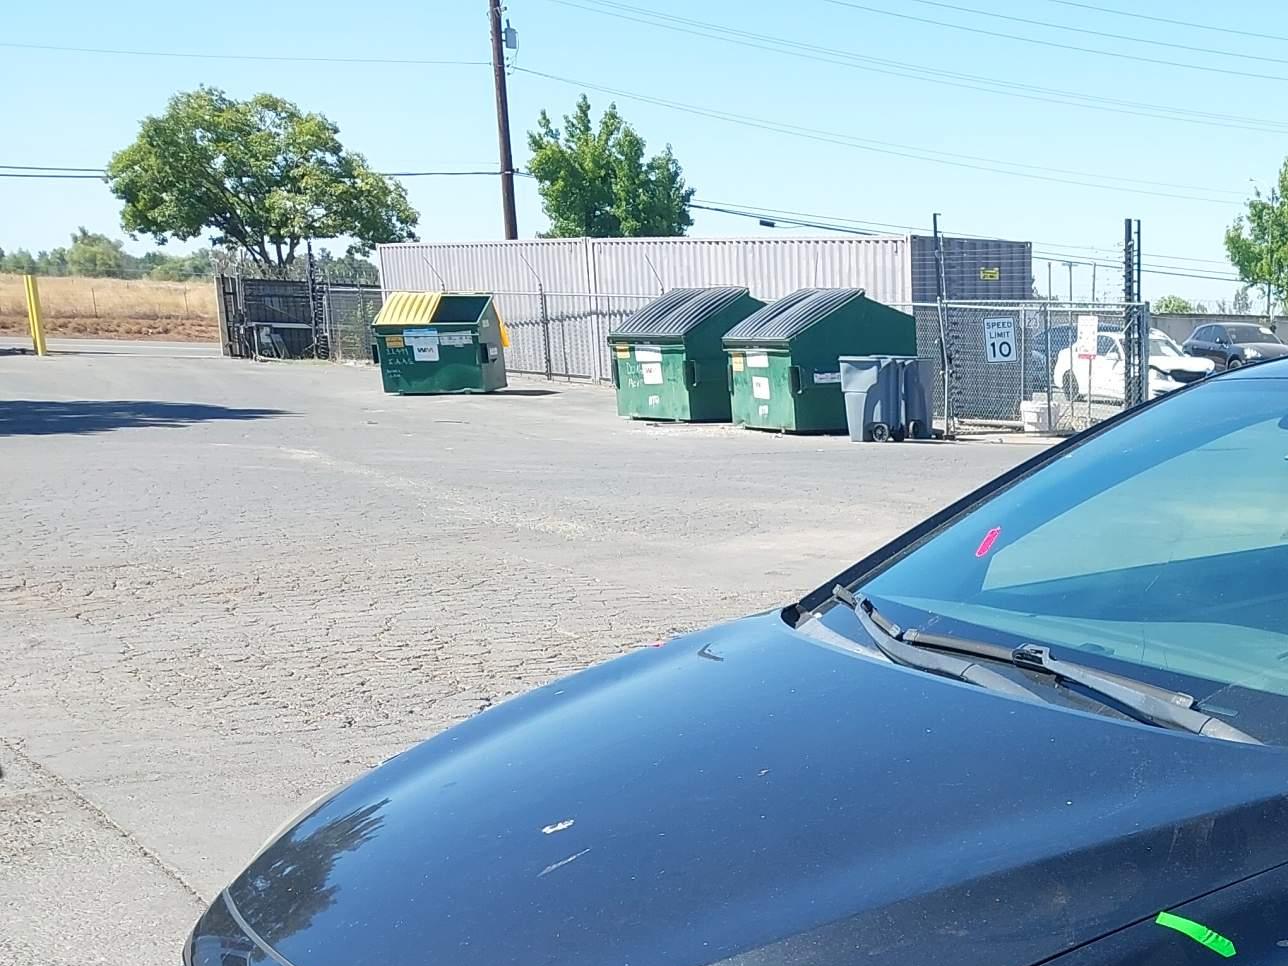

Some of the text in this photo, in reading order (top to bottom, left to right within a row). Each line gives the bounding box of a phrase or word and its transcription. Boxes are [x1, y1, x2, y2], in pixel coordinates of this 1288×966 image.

[986, 321, 1012, 330] SPEED
[989, 331, 1011, 339] LIMIT
[990, 341, 1012, 358] 10
